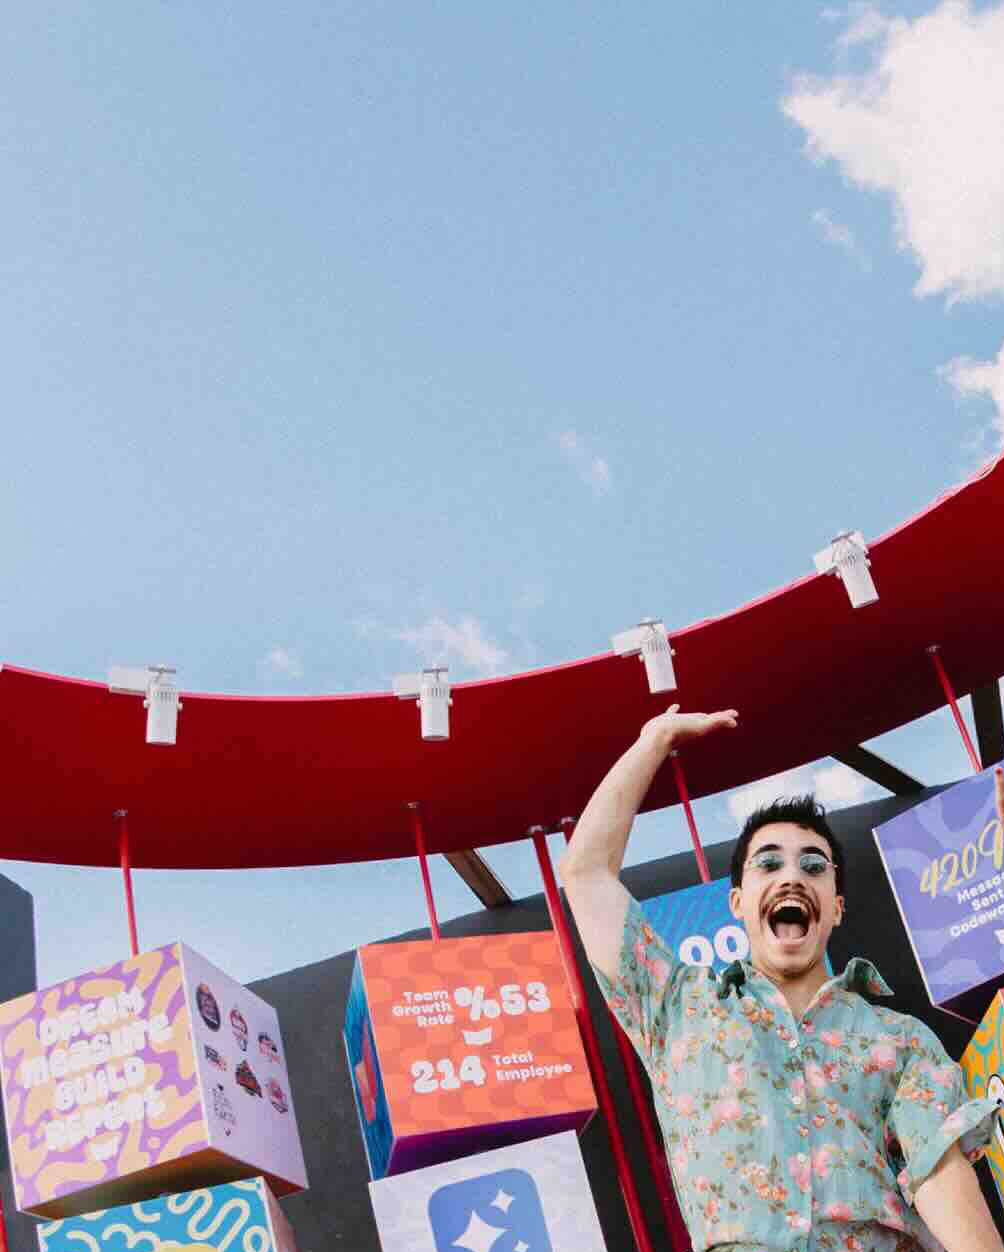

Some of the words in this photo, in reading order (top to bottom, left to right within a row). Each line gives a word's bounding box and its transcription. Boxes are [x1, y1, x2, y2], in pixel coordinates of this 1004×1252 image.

[403, 990, 449, 1004] Team
[454, 981, 551, 1022] %53
[40, 986, 147, 1046] DREAM
[392, 1001, 452, 1017] Growth
[416, 1014, 455, 1028] Rate
[492, 1050, 535, 1066] Total
[411, 1055, 486, 1094] 214
[495, 1062, 573, 1082] Employee
[55, 1056, 145, 1113] BUILD
